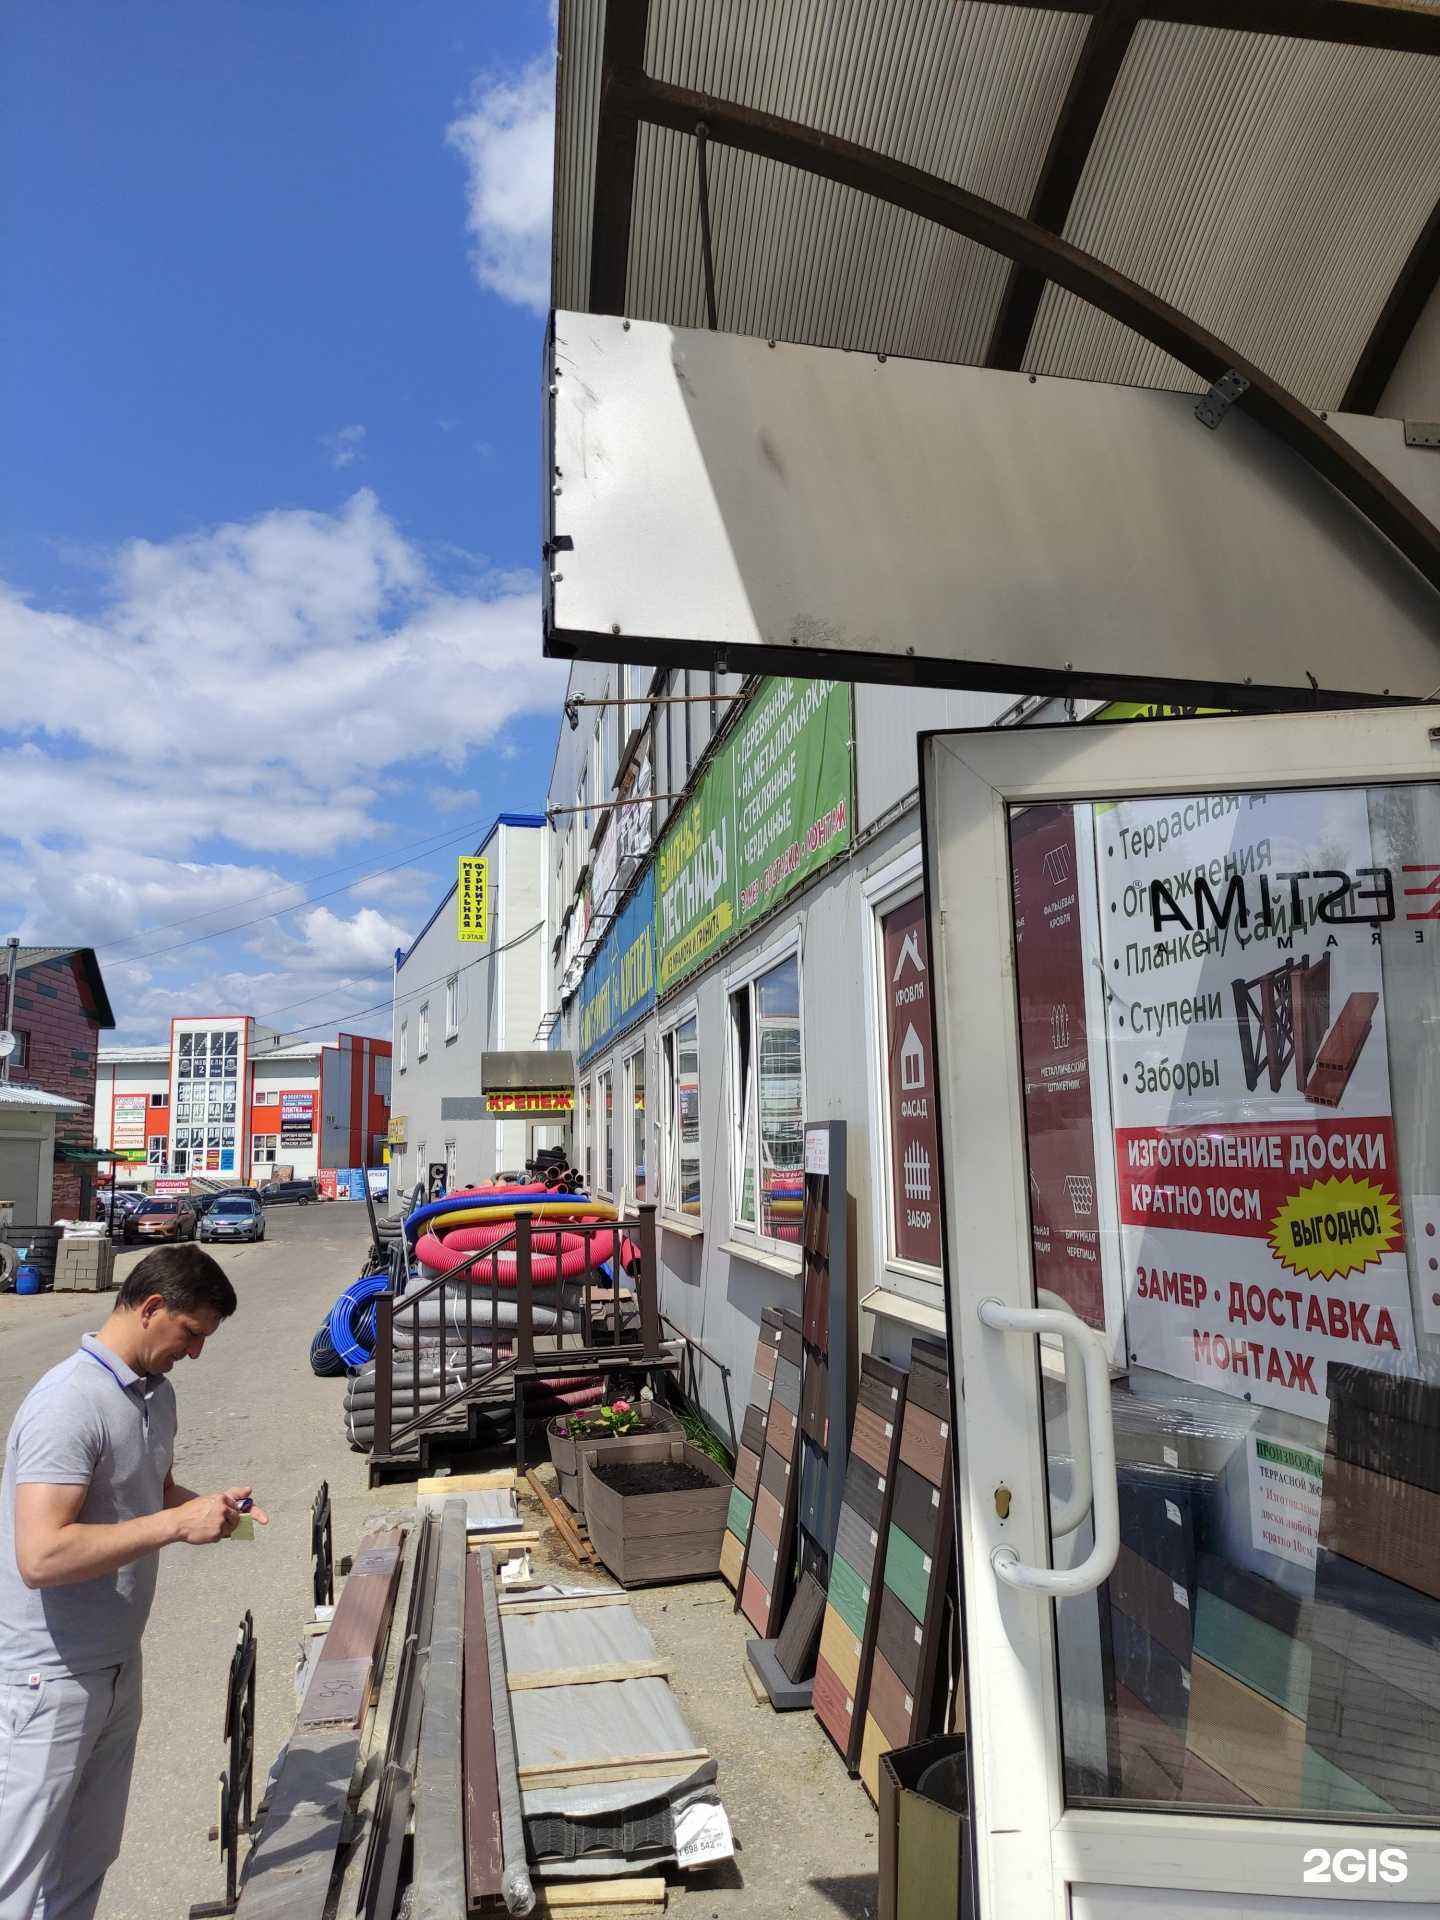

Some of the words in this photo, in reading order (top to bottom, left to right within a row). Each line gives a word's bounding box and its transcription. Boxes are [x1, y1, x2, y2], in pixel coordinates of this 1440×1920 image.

[742, 677, 795, 770] ДЕРЕВЯННЫЕ
[742, 767, 753, 799] НА
[754, 679, 838, 785] МЕТАЛЛОКАРКАС
[743, 751, 796, 833] СТЕКЛЯННЫЕ
[744, 798, 792, 865] ЧЕРДАЧНЫЕ
[1119, 796, 1239, 860] Террасная
[463, 862, 473, 928] МЕБЕЛЬНАЯ
[474, 863, 485, 928] ФУРНИТУРА
[662, 816, 728, 949] ЛЕСТНИЦЫ
[895, 982, 925, 1007] КРОВЛЯ
[1130, 991, 1222, 1037] Ступени
[1134, 1056, 1220, 1096] Заборы
[488, 1094, 573, 1109] КРЕПЕЖ
[901, 1098, 929, 1119] ФАСАД
[1128, 1136, 1283, 1169] ИЗГОТОВЛЕНИЕ
[1289, 1133, 1387, 1174] ДОСКИ
[906, 1208, 932, 1230] ЗАБОР
[1130, 1183, 1203, 1217] КРАТНО
[1206, 1187, 1262, 1221] 10СМ
[1290, 1205, 1382, 1248] ВЫГОДНО!
[1136, 1266, 1207, 1309] ЗАМЕР
[1228, 1281, 1401, 1351] ДОСТАВКА
[1192, 1328, 1319, 1396] МОНТАЖ
[1260, 1466, 1307, 1491] ТЕРРАСНОЙ
[700, 1840, 715, 1851] 542
